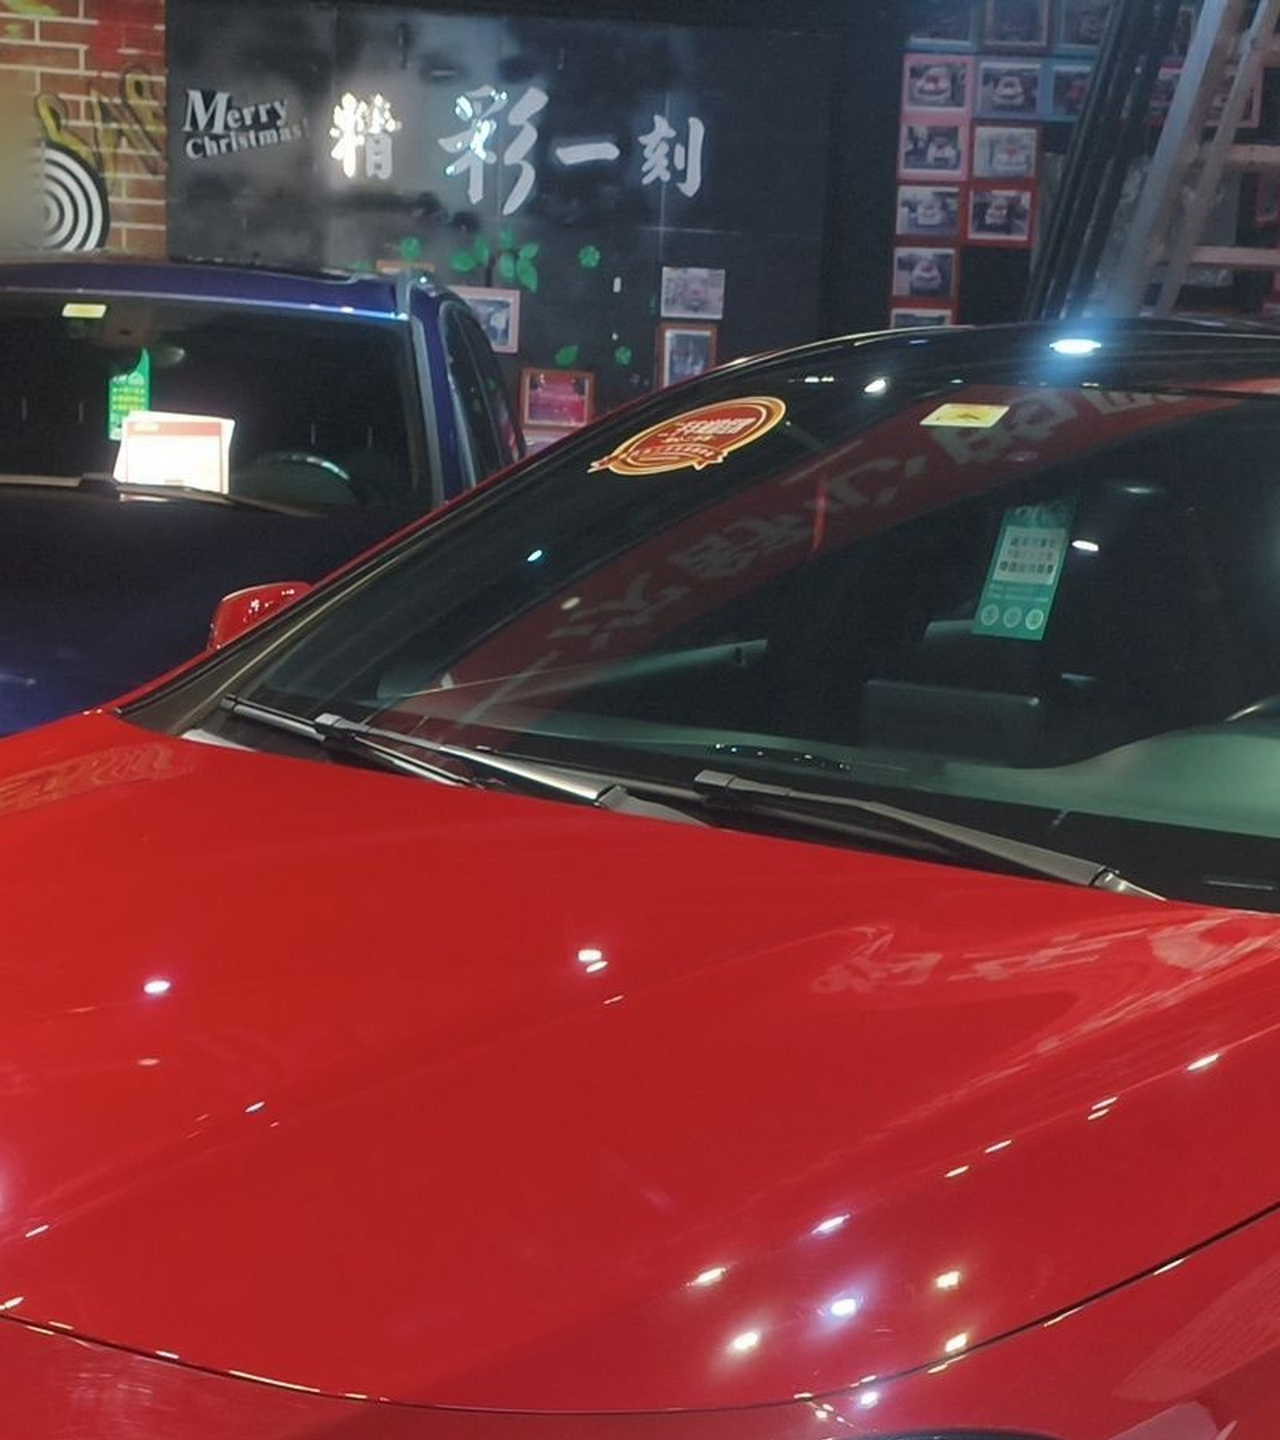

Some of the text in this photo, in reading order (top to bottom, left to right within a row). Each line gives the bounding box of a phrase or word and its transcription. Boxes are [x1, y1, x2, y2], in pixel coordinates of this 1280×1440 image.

[181, 89, 288, 135] Merry
[331, 84, 705, 217] 精彩一刻
